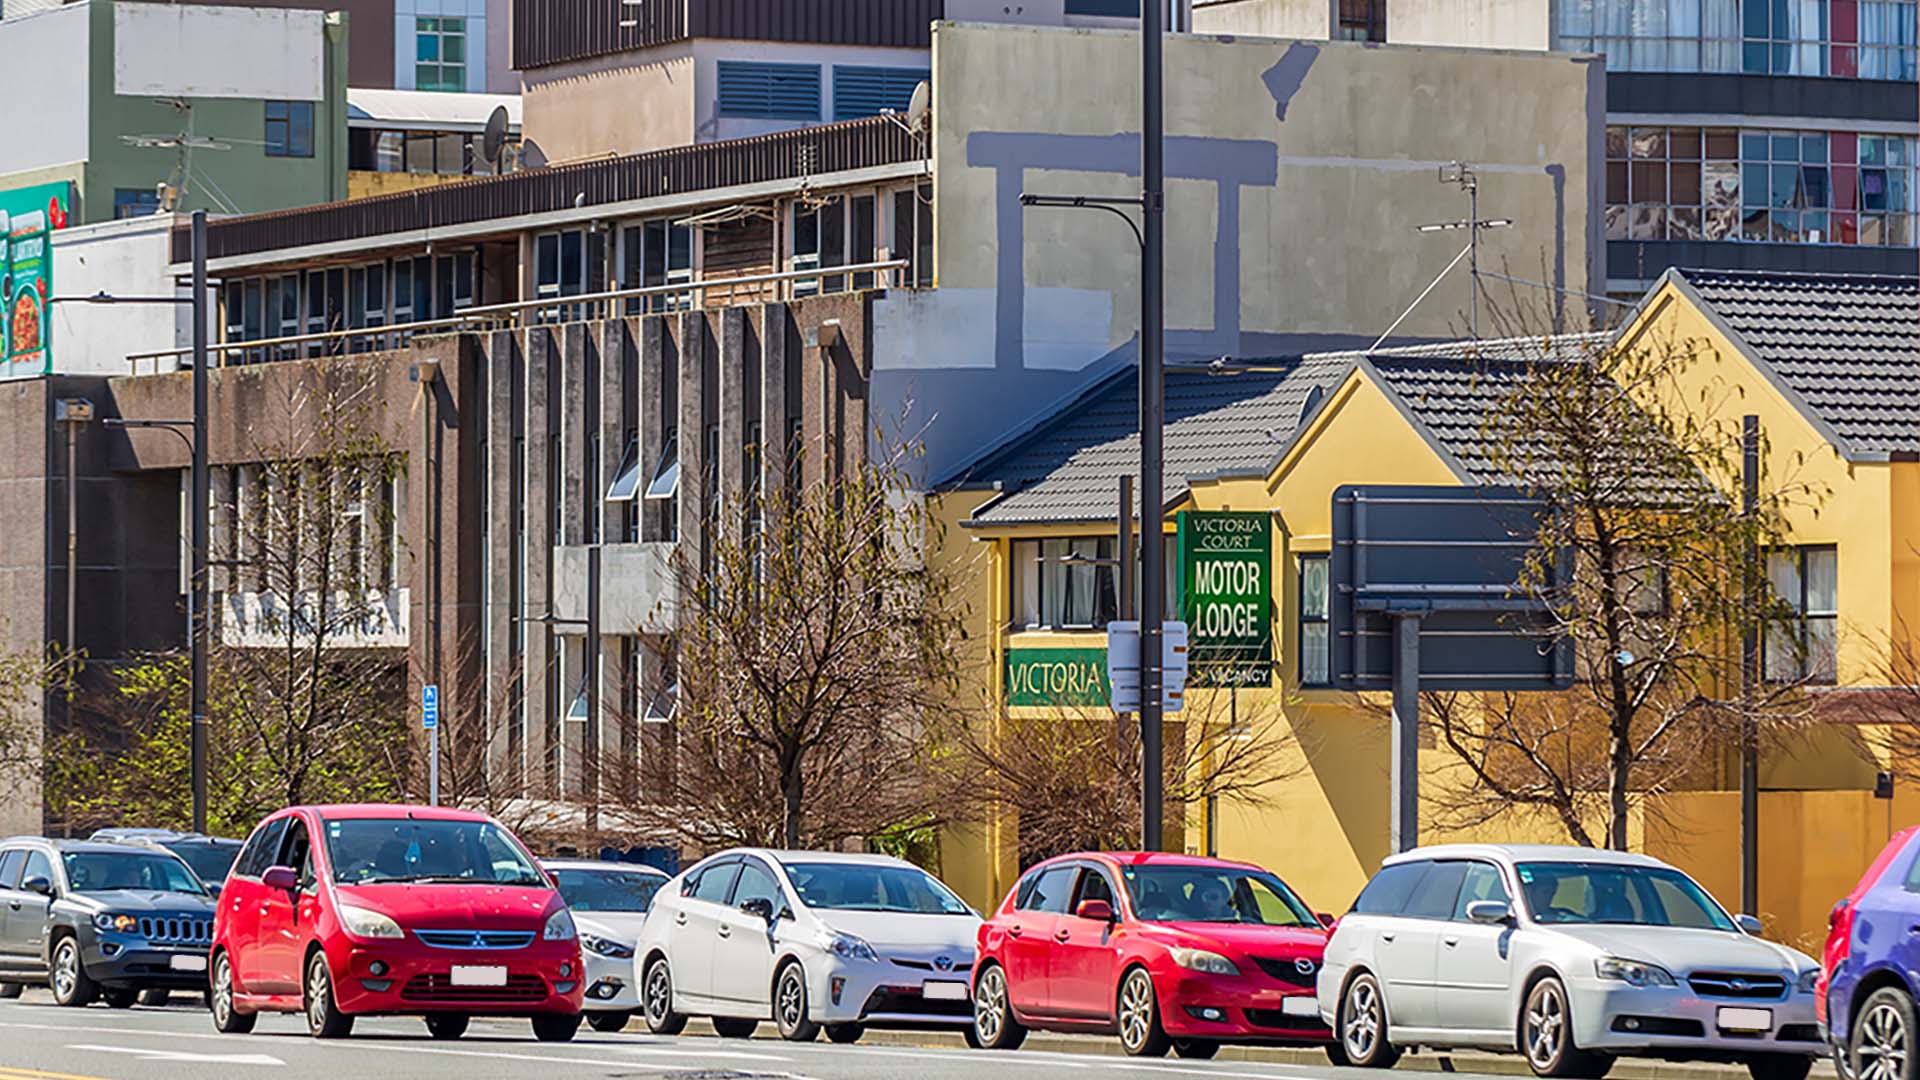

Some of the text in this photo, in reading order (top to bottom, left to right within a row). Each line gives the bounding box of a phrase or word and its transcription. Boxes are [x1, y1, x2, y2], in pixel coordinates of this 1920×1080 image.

[1193, 519, 1262, 532] VICTORIA
[1201, 535, 1252, 549] COURT
[1195, 560, 1260, 595] MOTOR
[1196, 602, 1259, 637] LODGE
[1008, 662, 1102, 694] VICTORIA
[1209, 668, 1269, 682] VCANCY
